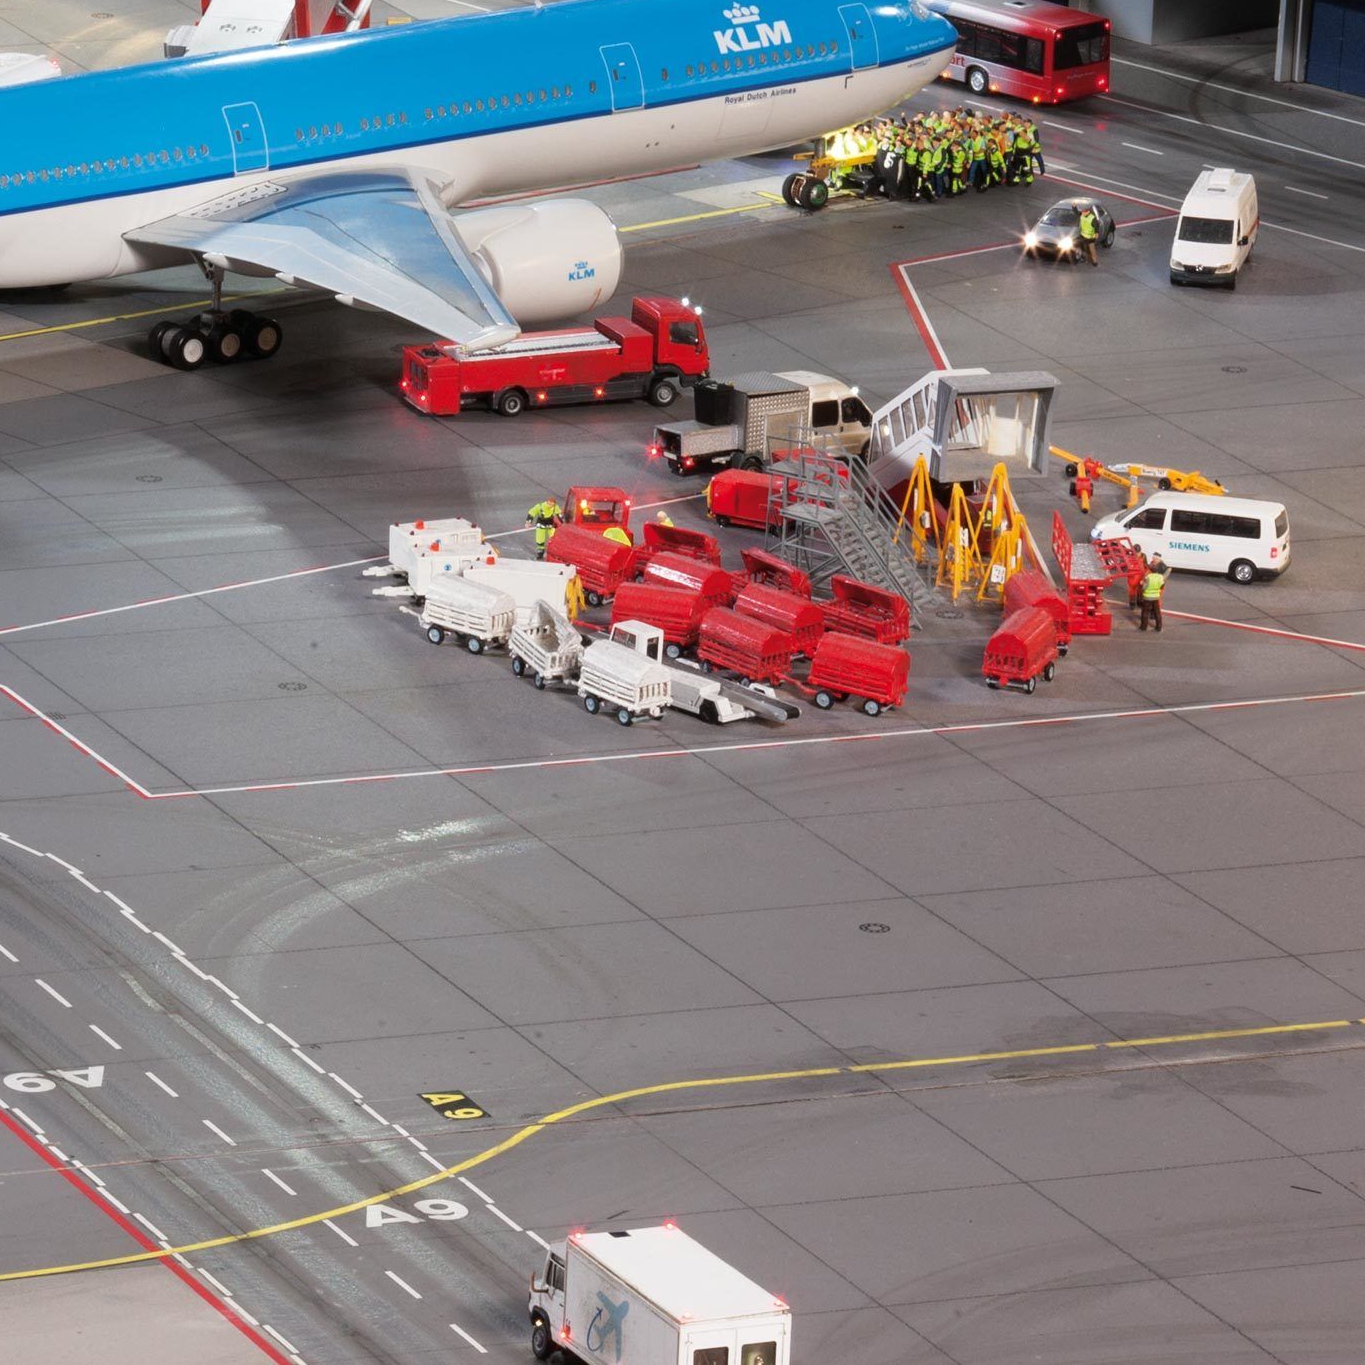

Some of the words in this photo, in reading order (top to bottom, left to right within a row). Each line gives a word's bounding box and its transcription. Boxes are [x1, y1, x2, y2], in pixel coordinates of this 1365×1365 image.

[712, 20, 793, 55] KLM
[724, 93, 745, 105] Royal
[747, 91, 768, 102] Dutch
[770, 88, 797, 99] Airlines
[568, 268, 595, 281] KLM
[1168, 541, 1210, 553] SIEMENS
[3, 1065, 105, 1093] A9
[366, 1198, 470, 1228] A9
